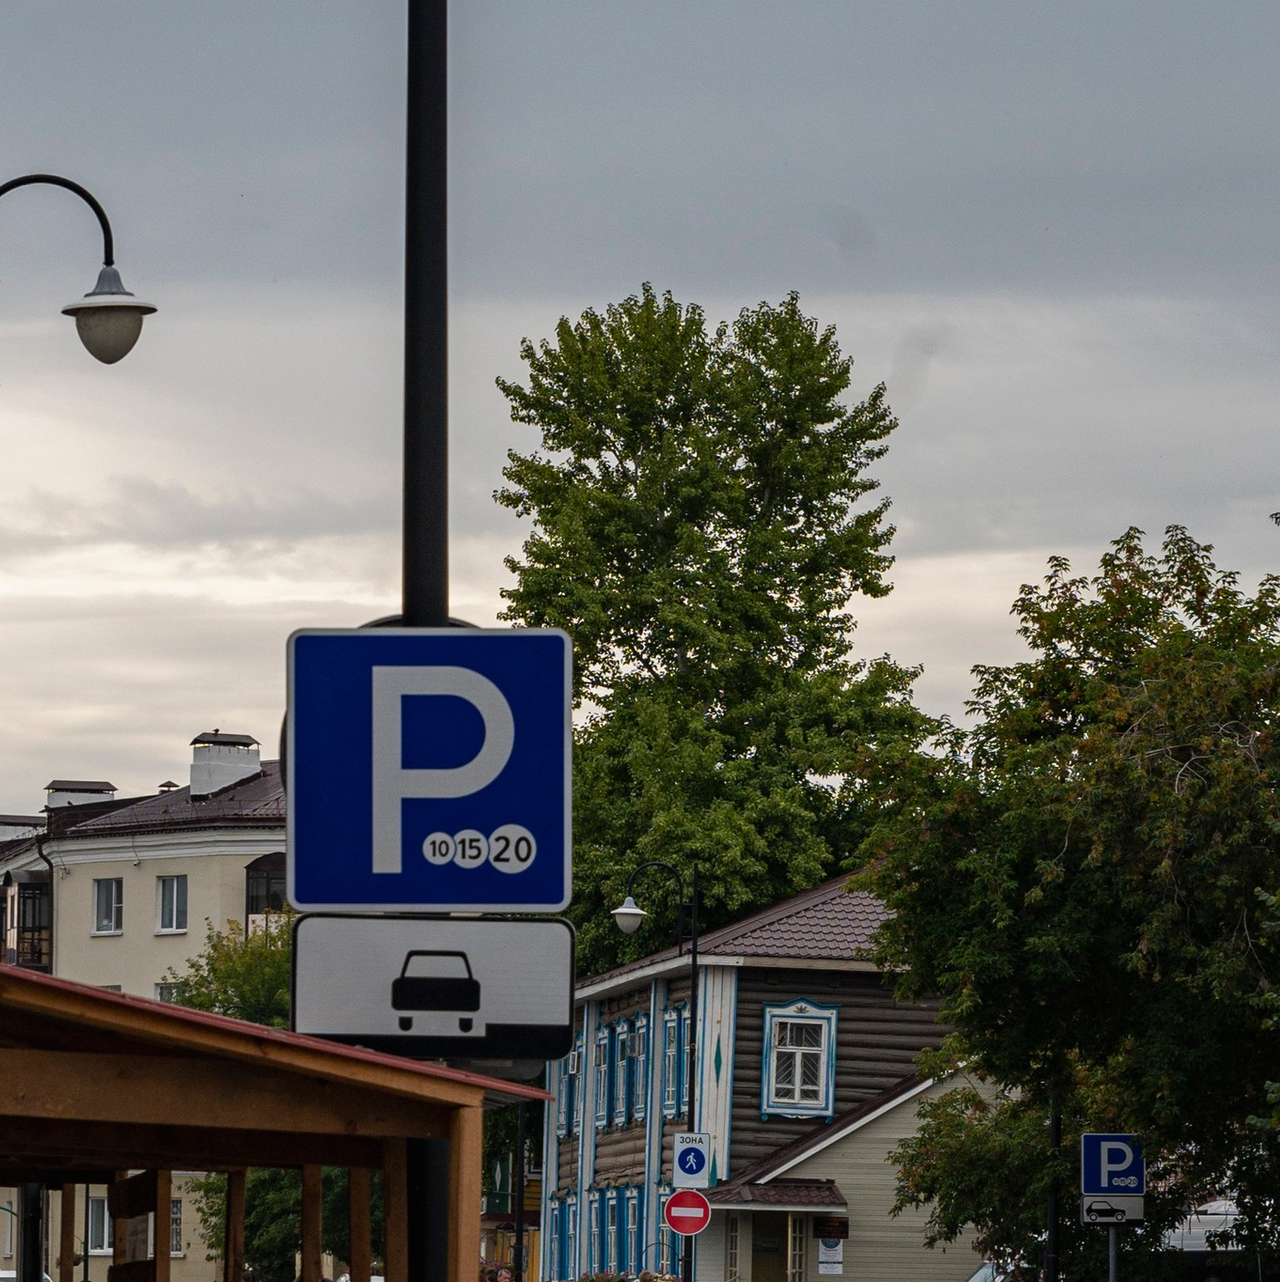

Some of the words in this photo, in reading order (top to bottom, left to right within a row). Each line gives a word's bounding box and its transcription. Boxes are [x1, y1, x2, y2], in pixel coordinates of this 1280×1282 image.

[372, 665, 515, 874] P
[429, 841, 450, 858] 10
[458, 838, 482, 860] 15
[492, 835, 532, 863] 20
[679, 1136, 704, 1145] ЗОНА
[1100, 1141, 1134, 1188] P
[1127, 1178, 1137, 1186] 20
